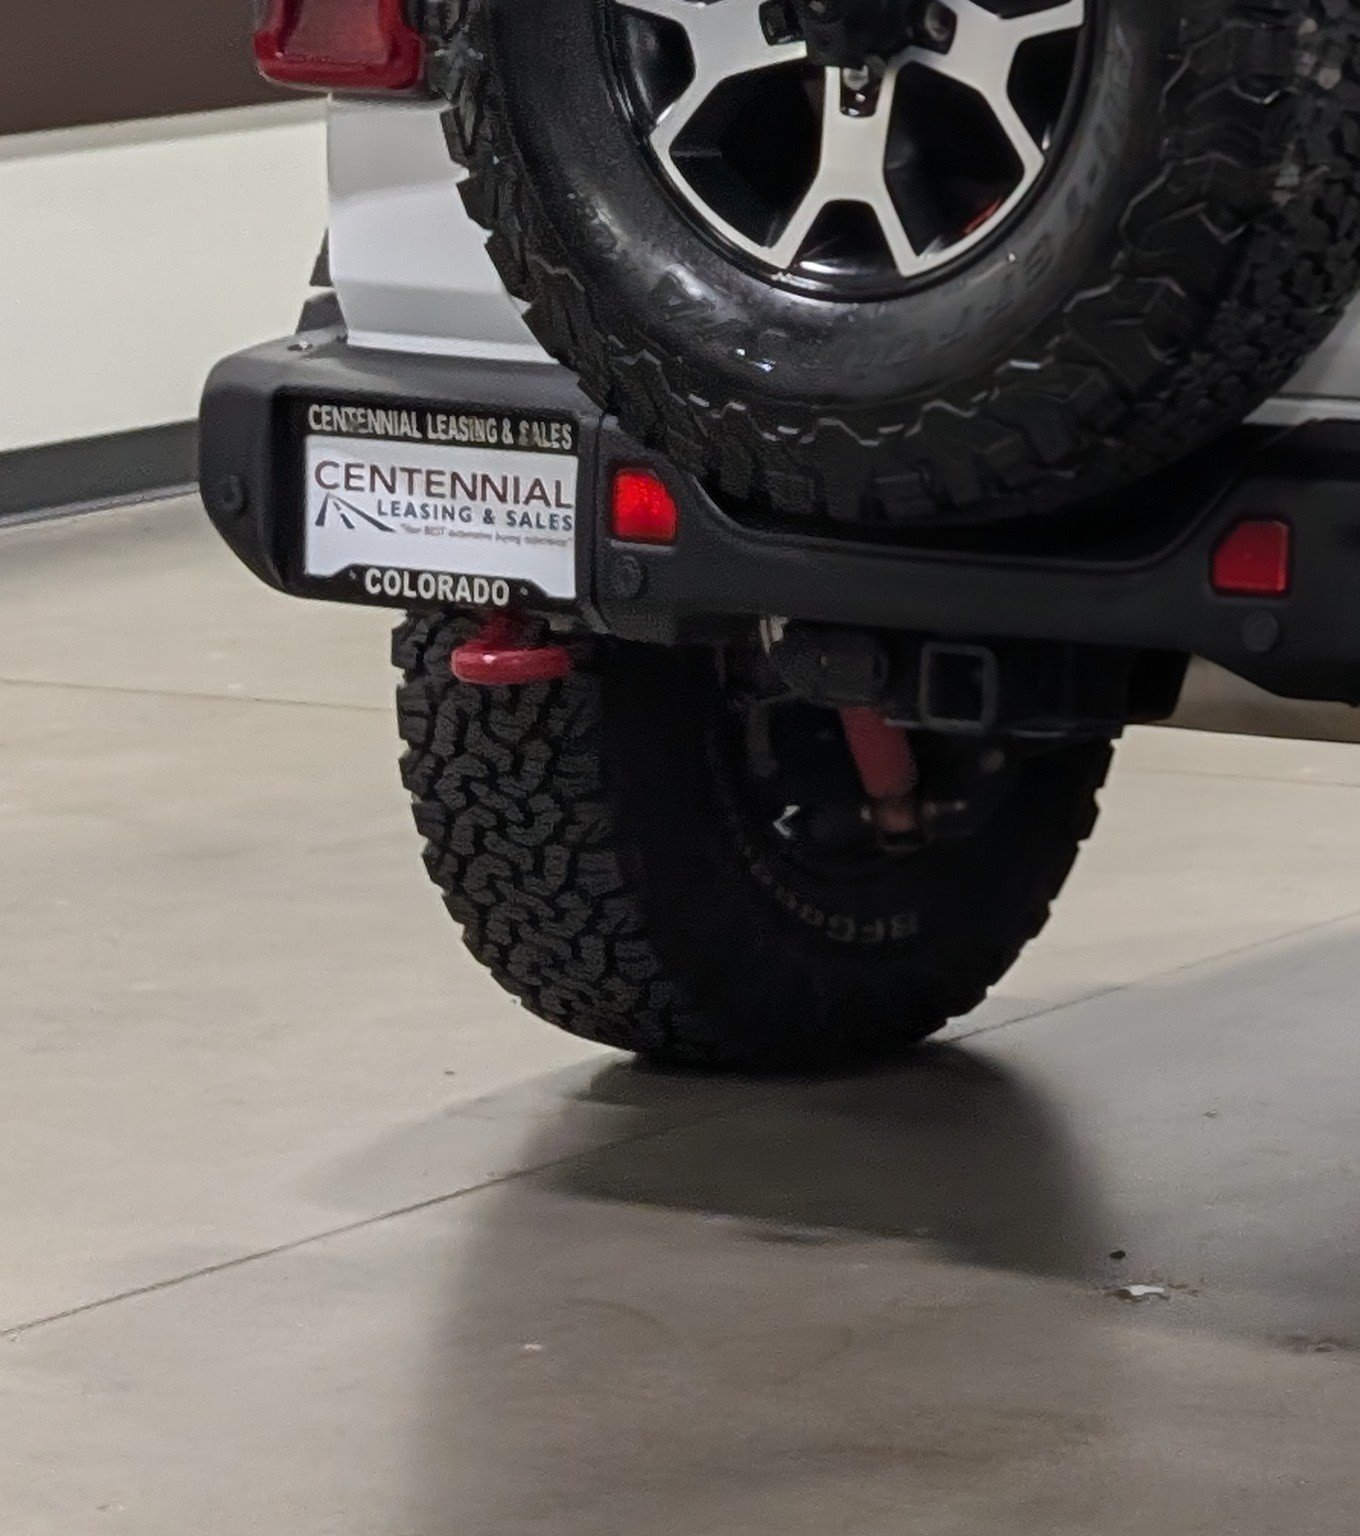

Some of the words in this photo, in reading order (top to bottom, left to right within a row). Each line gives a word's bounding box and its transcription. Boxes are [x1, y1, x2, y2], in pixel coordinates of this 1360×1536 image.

[308, 404, 423, 439] CENTENNIAL
[426, 412, 499, 445] LEASING
[501, 417, 515, 445] &
[518, 420, 573, 450] SALES
[315, 460, 573, 510] CENTENNIAL
[377, 499, 472, 523] LEASING
[482, 507, 495, 525] &
[506, 509, 573, 532] SALES
[365, 567, 510, 606] COLORADO
